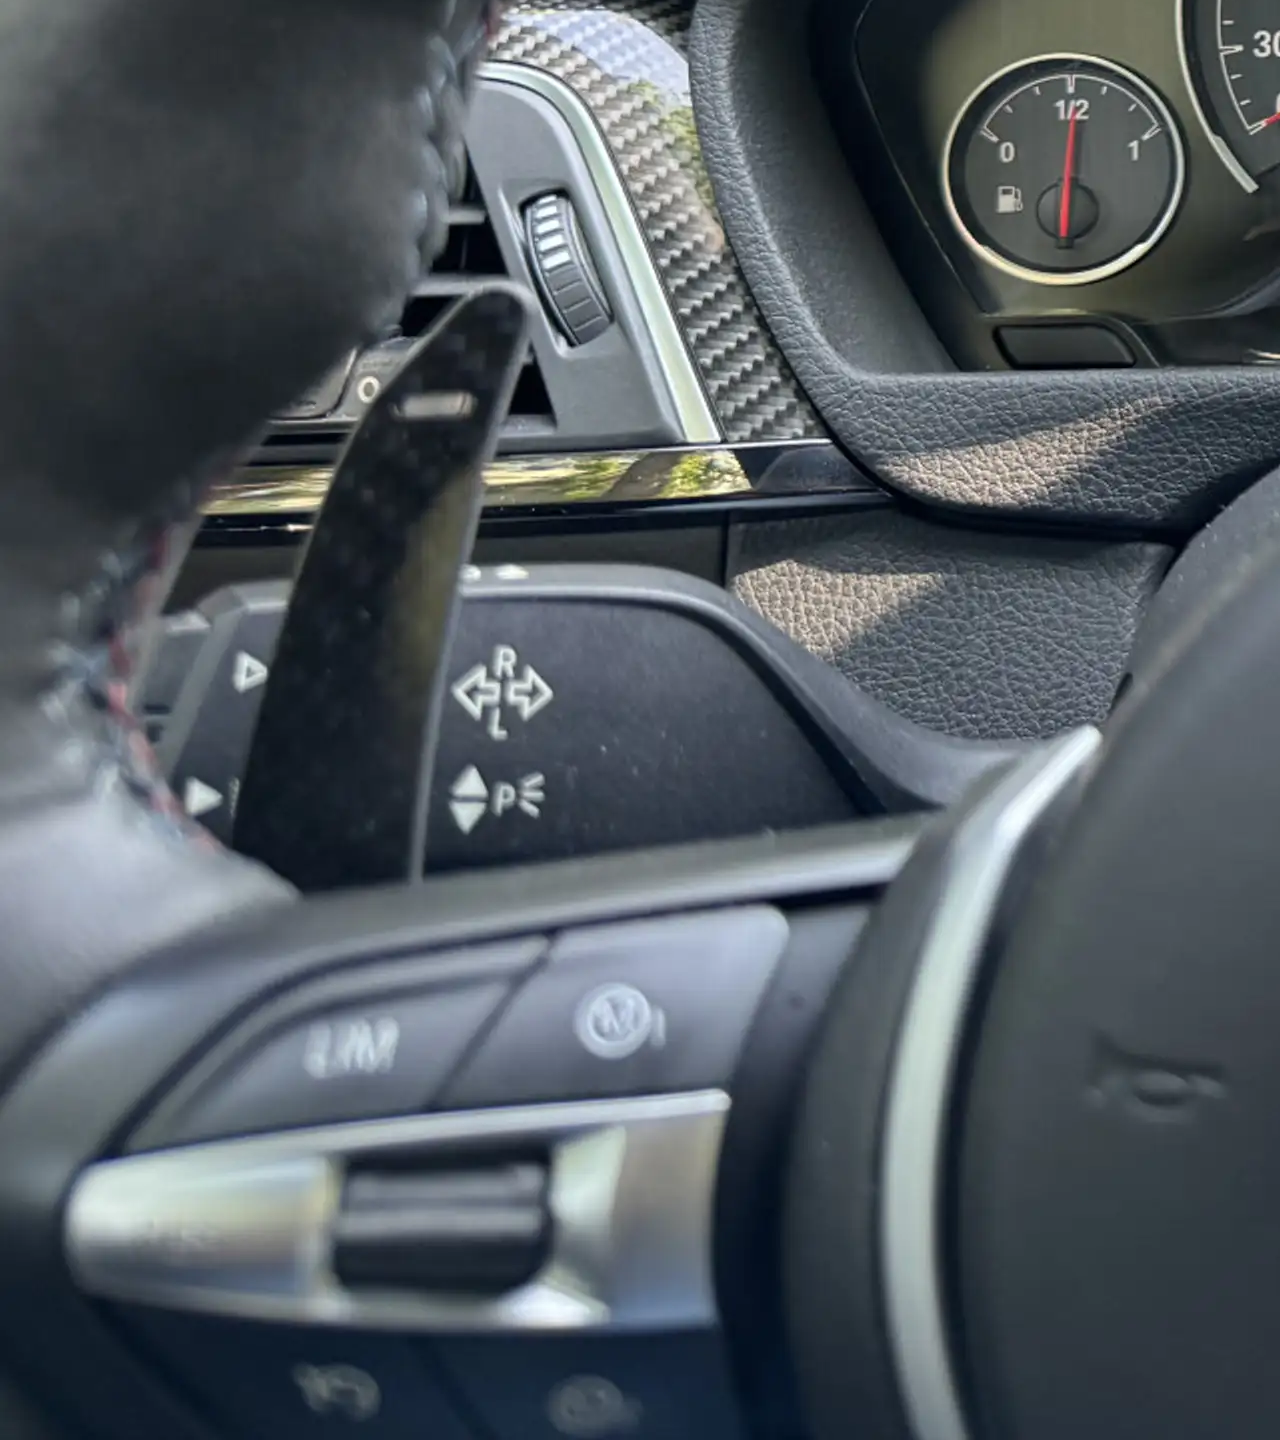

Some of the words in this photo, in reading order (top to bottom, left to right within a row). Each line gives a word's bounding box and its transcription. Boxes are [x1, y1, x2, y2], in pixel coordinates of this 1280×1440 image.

[1054, 100, 1090, 121] 1/2
[1000, 142, 1015, 163] 0
[1128, 140, 1139, 160] 1
[493, 644, 517, 679] R
[488, 707, 508, 741] L
[492, 781, 516, 817] P
